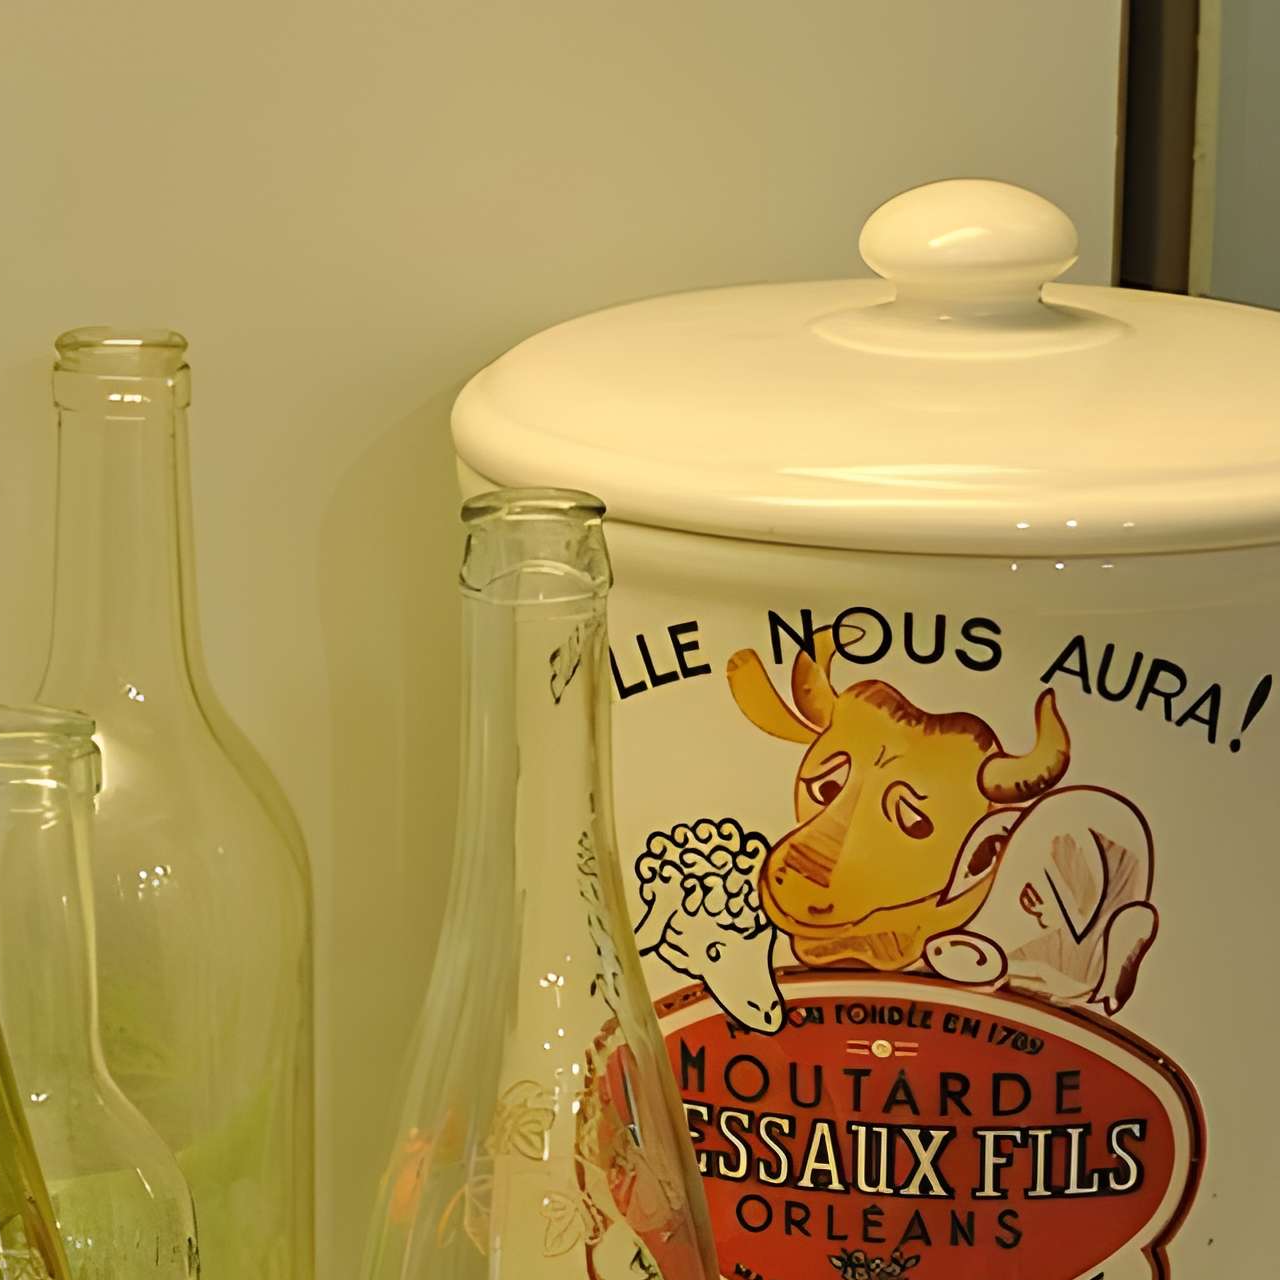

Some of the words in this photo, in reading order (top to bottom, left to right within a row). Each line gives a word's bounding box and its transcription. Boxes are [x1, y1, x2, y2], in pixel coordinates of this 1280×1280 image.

[609, 620, 712, 701] LLE
[767, 606, 1004, 673] NOUS
[1039, 634, 1274, 754] AURA!
[679, 1037, 1084, 1117] MOUTARDE
[681, 1098, 957, 1201] ESSAUX
[974, 1117, 1149, 1201] FILS
